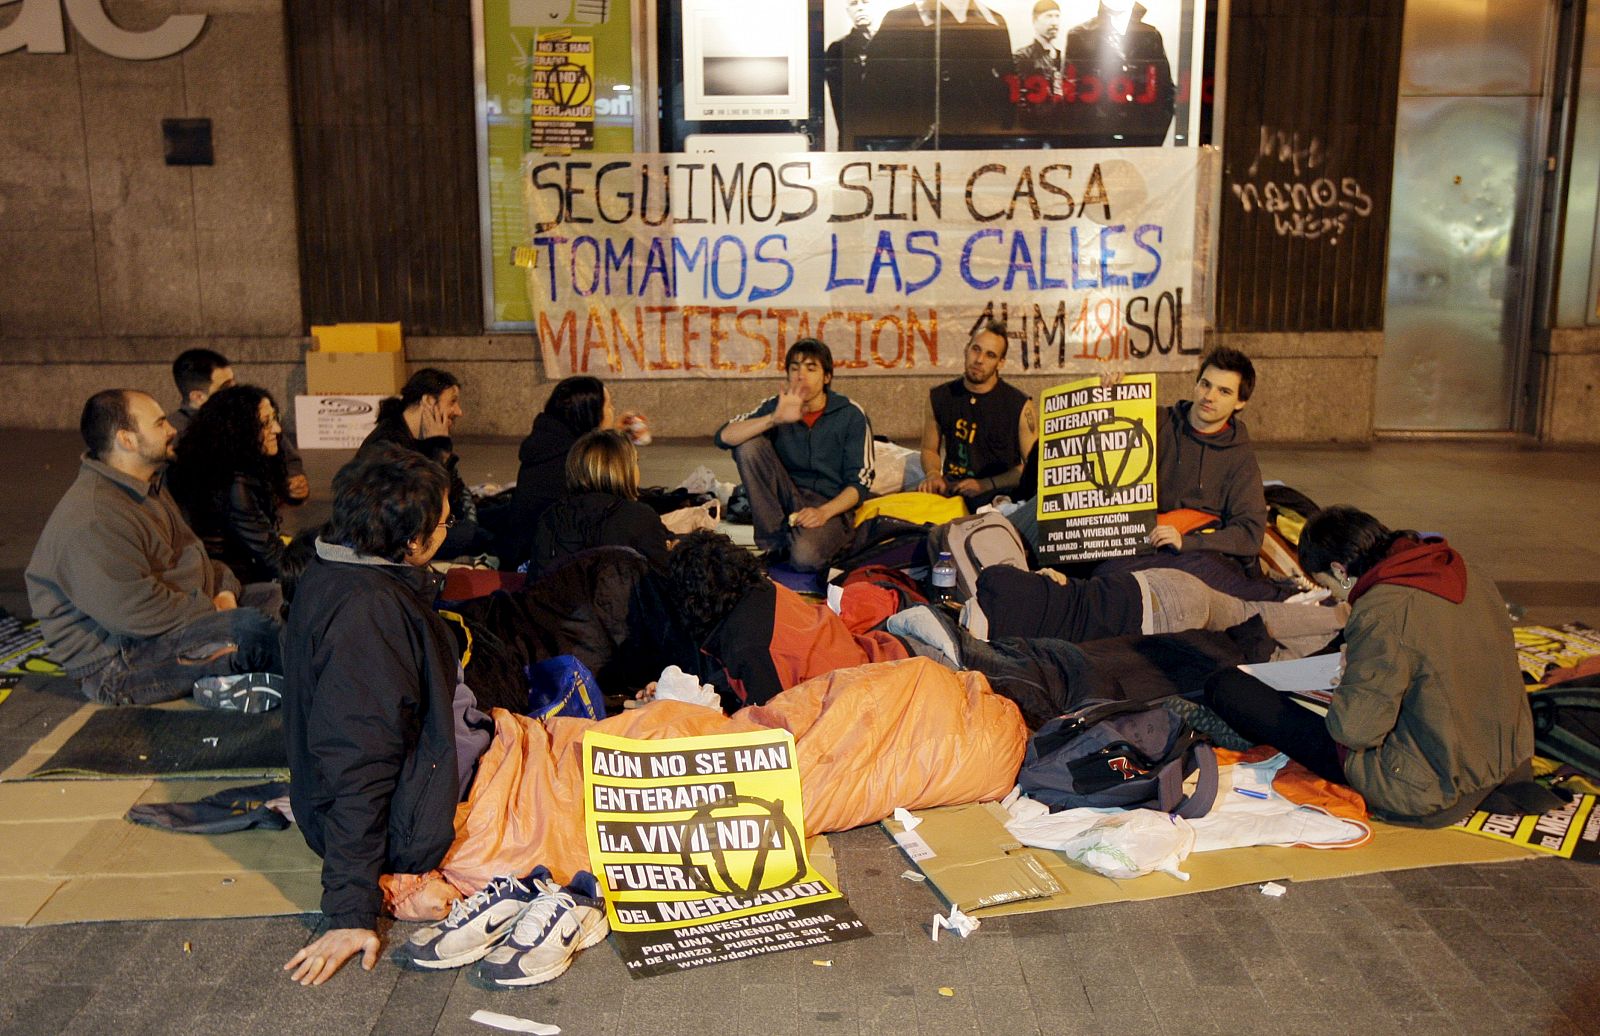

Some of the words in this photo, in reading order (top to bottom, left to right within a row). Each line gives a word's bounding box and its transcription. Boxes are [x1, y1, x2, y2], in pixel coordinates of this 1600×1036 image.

[532, 161, 818, 233] SEGUIMOS
[827, 161, 942, 223] SIN
[964, 162, 1112, 223] CASA
[533, 234, 794, 302] TOMAMOS
[825, 230, 943, 296] LAS
[959, 224, 1163, 291] CALLES
[1126, 287, 1201, 359] SOL
[1045, 395, 1068, 413] AÚN
[1072, 390, 1088, 407] NO
[1092, 388, 1112, 402] SE
[1117, 384, 1150, 400] HAN
[1043, 500, 1061, 513] DEL
[1062, 484, 1152, 510] MERCADO!
[1048, 531, 1063, 541] POR
[1065, 529, 1080, 540] UNA
[1082, 526, 1119, 538] VIVIENDA
[1121, 523, 1146, 535] DIGNA
[1066, 513, 1129, 527] MANIFESTACIÓN
[1046, 544, 1055, 552] DE
[1056, 542, 1078, 551] MARZO
[1083, 540, 1109, 549] PUERTA
[1110, 538, 1122, 547] DEL
[1124, 537, 1137, 545] SOL
[593, 751, 642, 778] AÚN
[650, 754, 687, 777] NO
[695, 753, 728, 775] SE
[735, 746, 788, 772] HAN
[617, 908, 656, 925] DEL
[656, 882, 828, 922] MERCADO!
[641, 942, 675, 956] POR
[679, 935, 710, 949] UNA
[714, 923, 786, 945] VIVIENDA
[791, 913, 836, 930] DIGNA
[674, 909, 796, 938] MANIFESTACIÓN
[626, 960, 642, 969] 14
[643, 956, 664, 967] DE
[665, 947, 712, 963] MARZO
[723, 936, 774, 951] PUERTA
[776, 931, 800, 943] DEL
[802, 927, 826, 937] SOL
[836, 923, 851, 932] 18
[853, 919, 863, 928] H
[677, 935, 832, 970] www.vdevivienda.net
